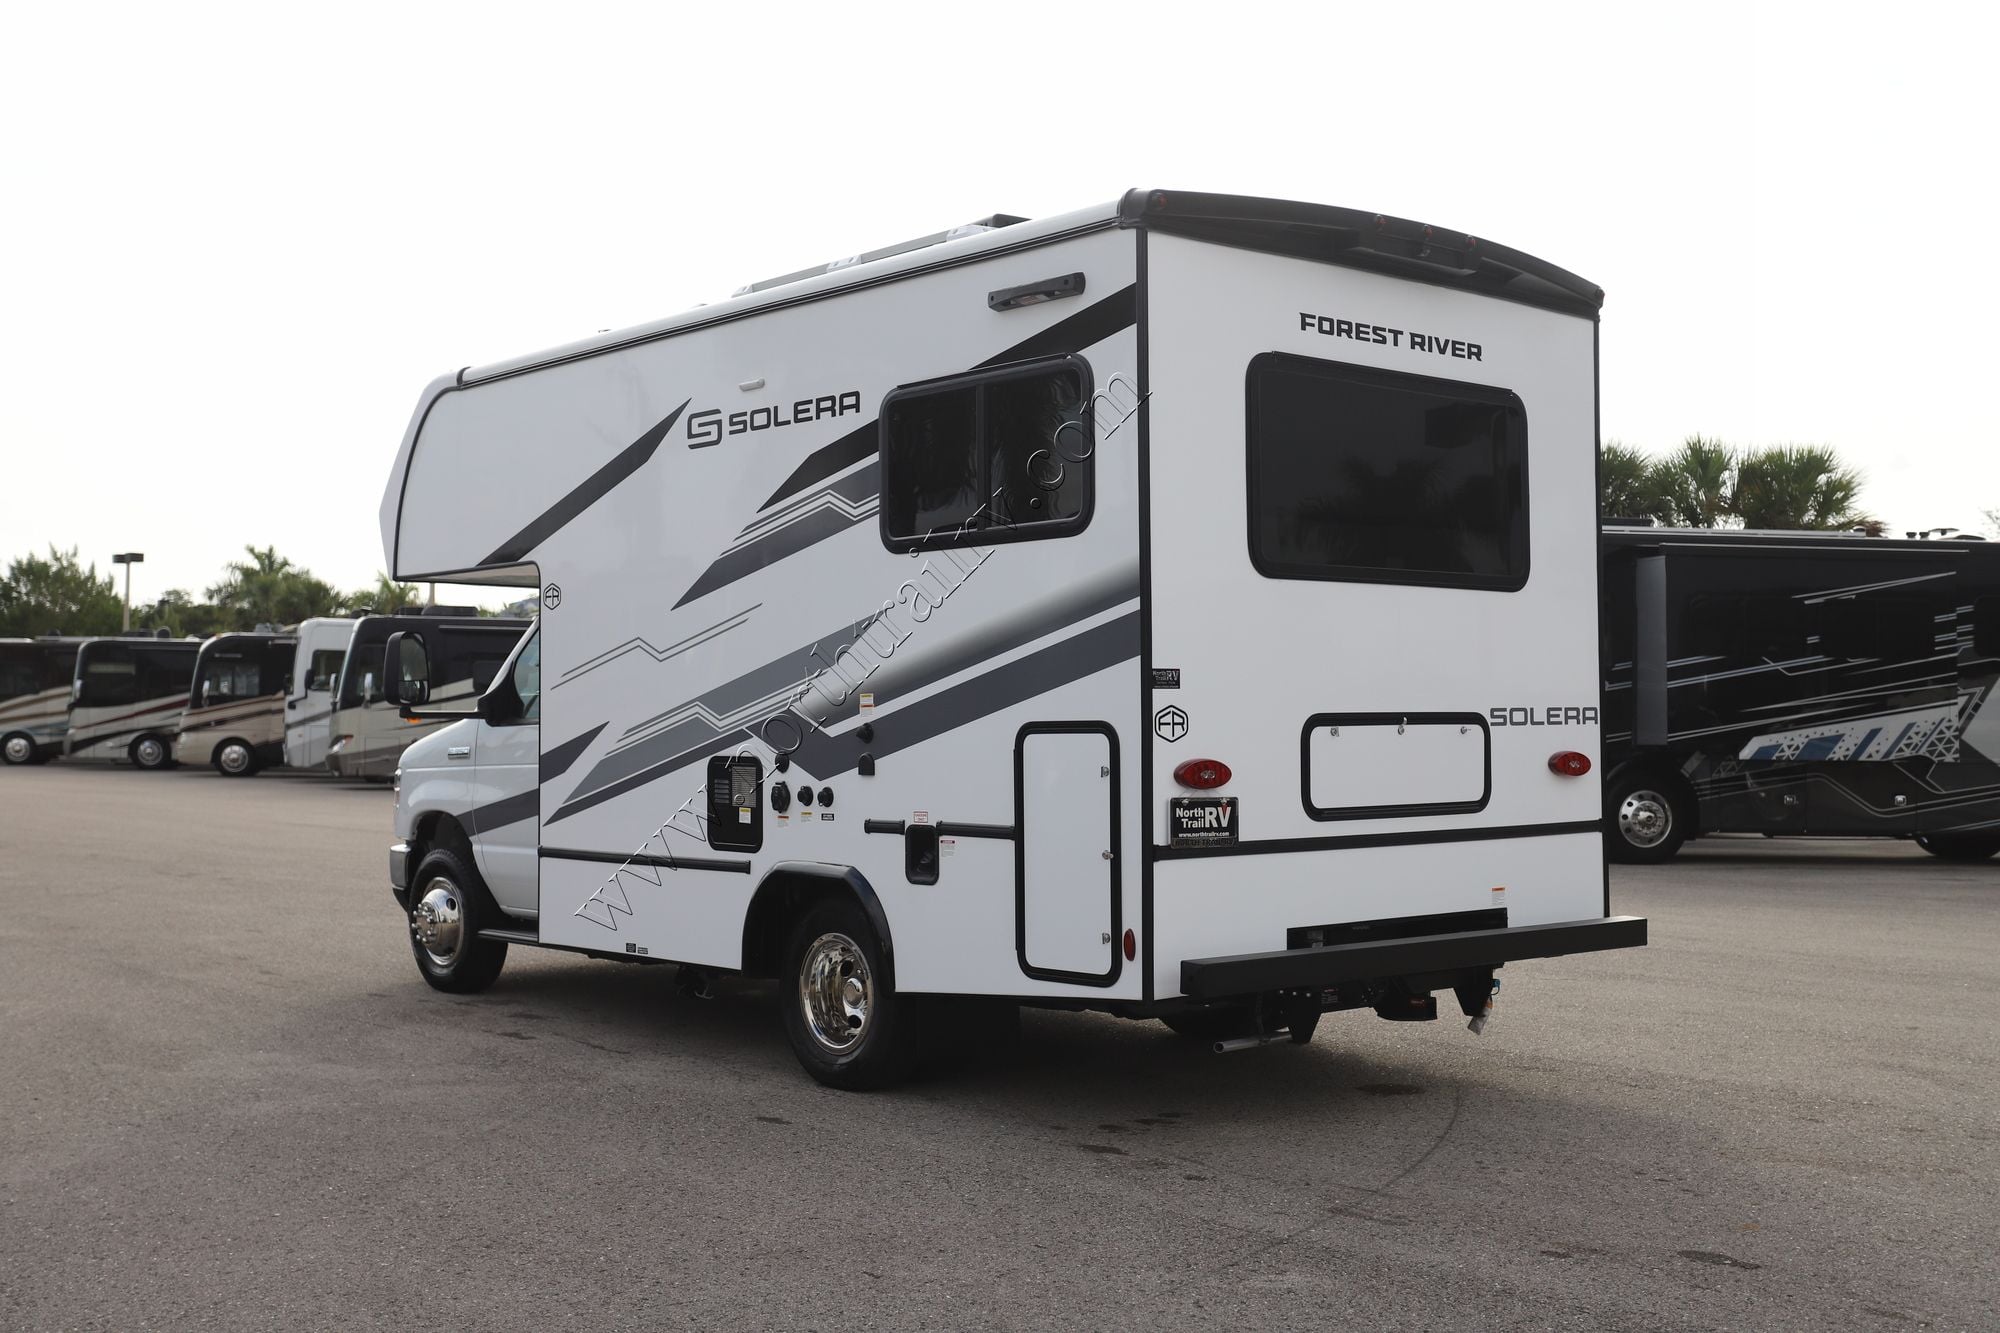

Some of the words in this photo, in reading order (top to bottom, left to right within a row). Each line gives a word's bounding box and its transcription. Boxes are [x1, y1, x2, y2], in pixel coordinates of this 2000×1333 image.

[1299, 312, 1404, 347] FOREST
[1409, 332, 1482, 361] RIVER
[728, 390, 861, 436] SOLERA
[1490, 707, 1599, 727] SOLERA
[1175, 807, 1204, 818] North
[1181, 818, 1204, 828] Trail
[1204, 806, 1232, 828] RV
